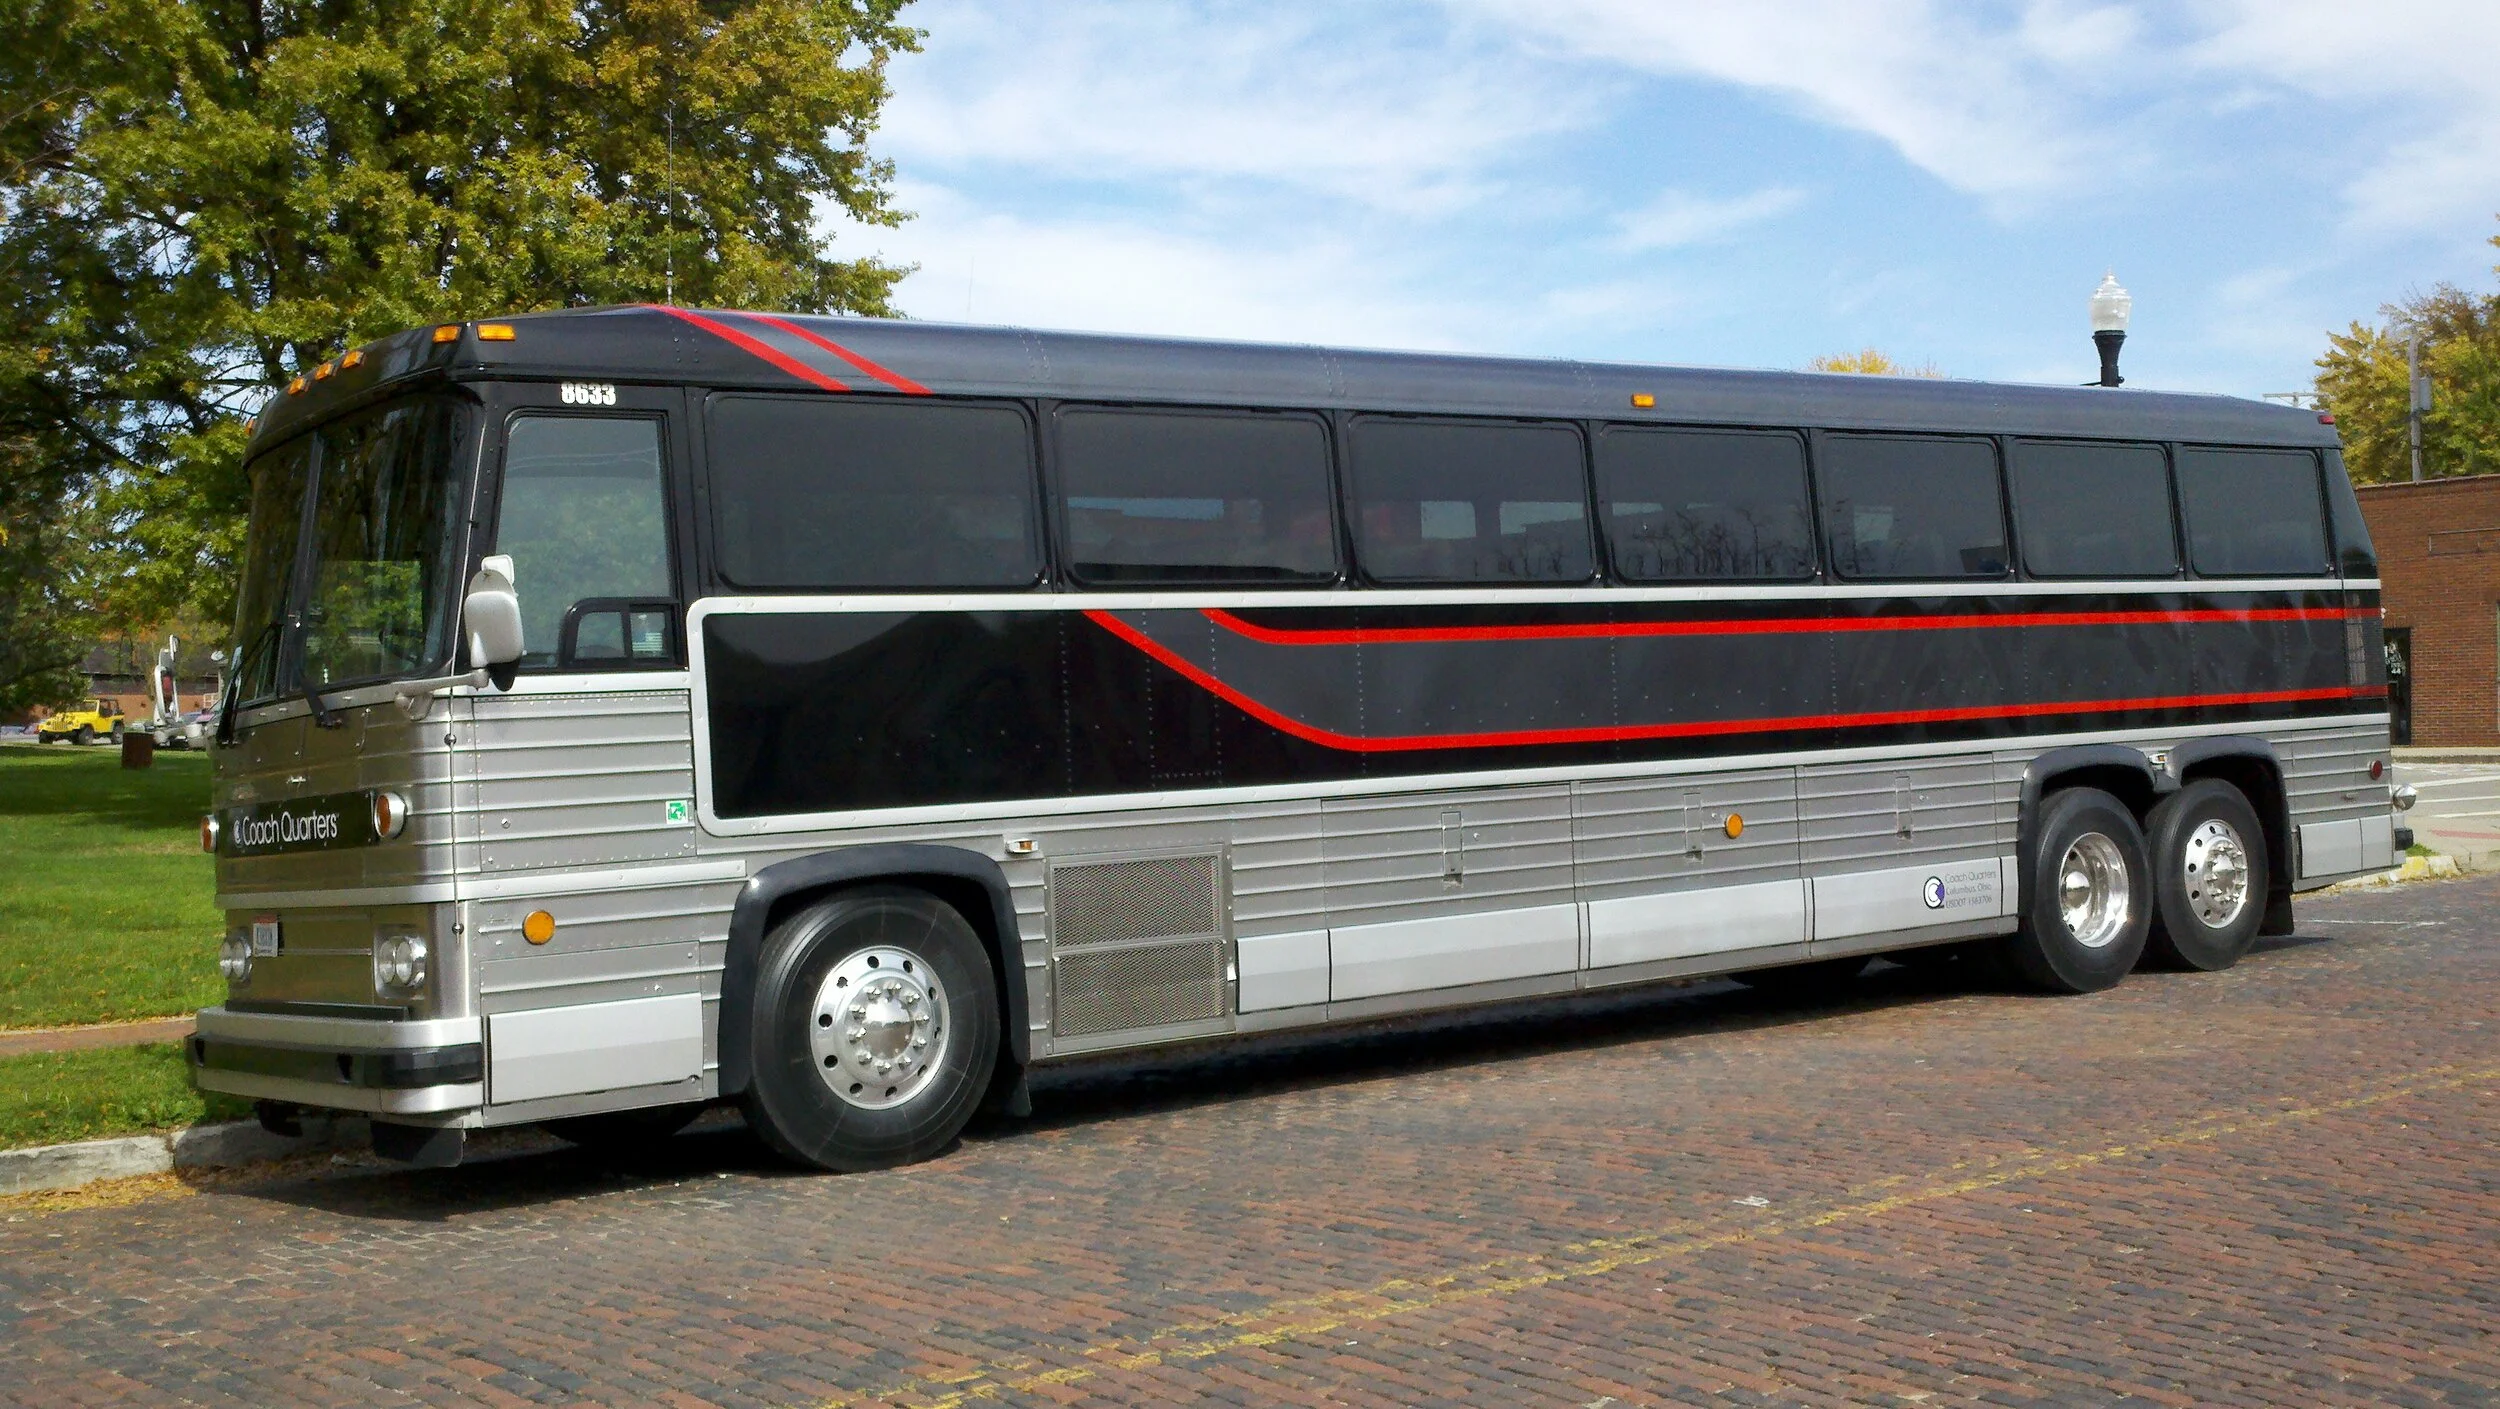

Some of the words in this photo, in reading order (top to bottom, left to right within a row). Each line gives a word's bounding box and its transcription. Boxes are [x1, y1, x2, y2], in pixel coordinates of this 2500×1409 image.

[561, 382, 616, 405] 8633
[242, 813, 280, 846] Coach
[281, 810, 338, 842] Quarters
[1945, 873, 1967, 883] Coach
[1968, 871, 1996, 881] Quarters
